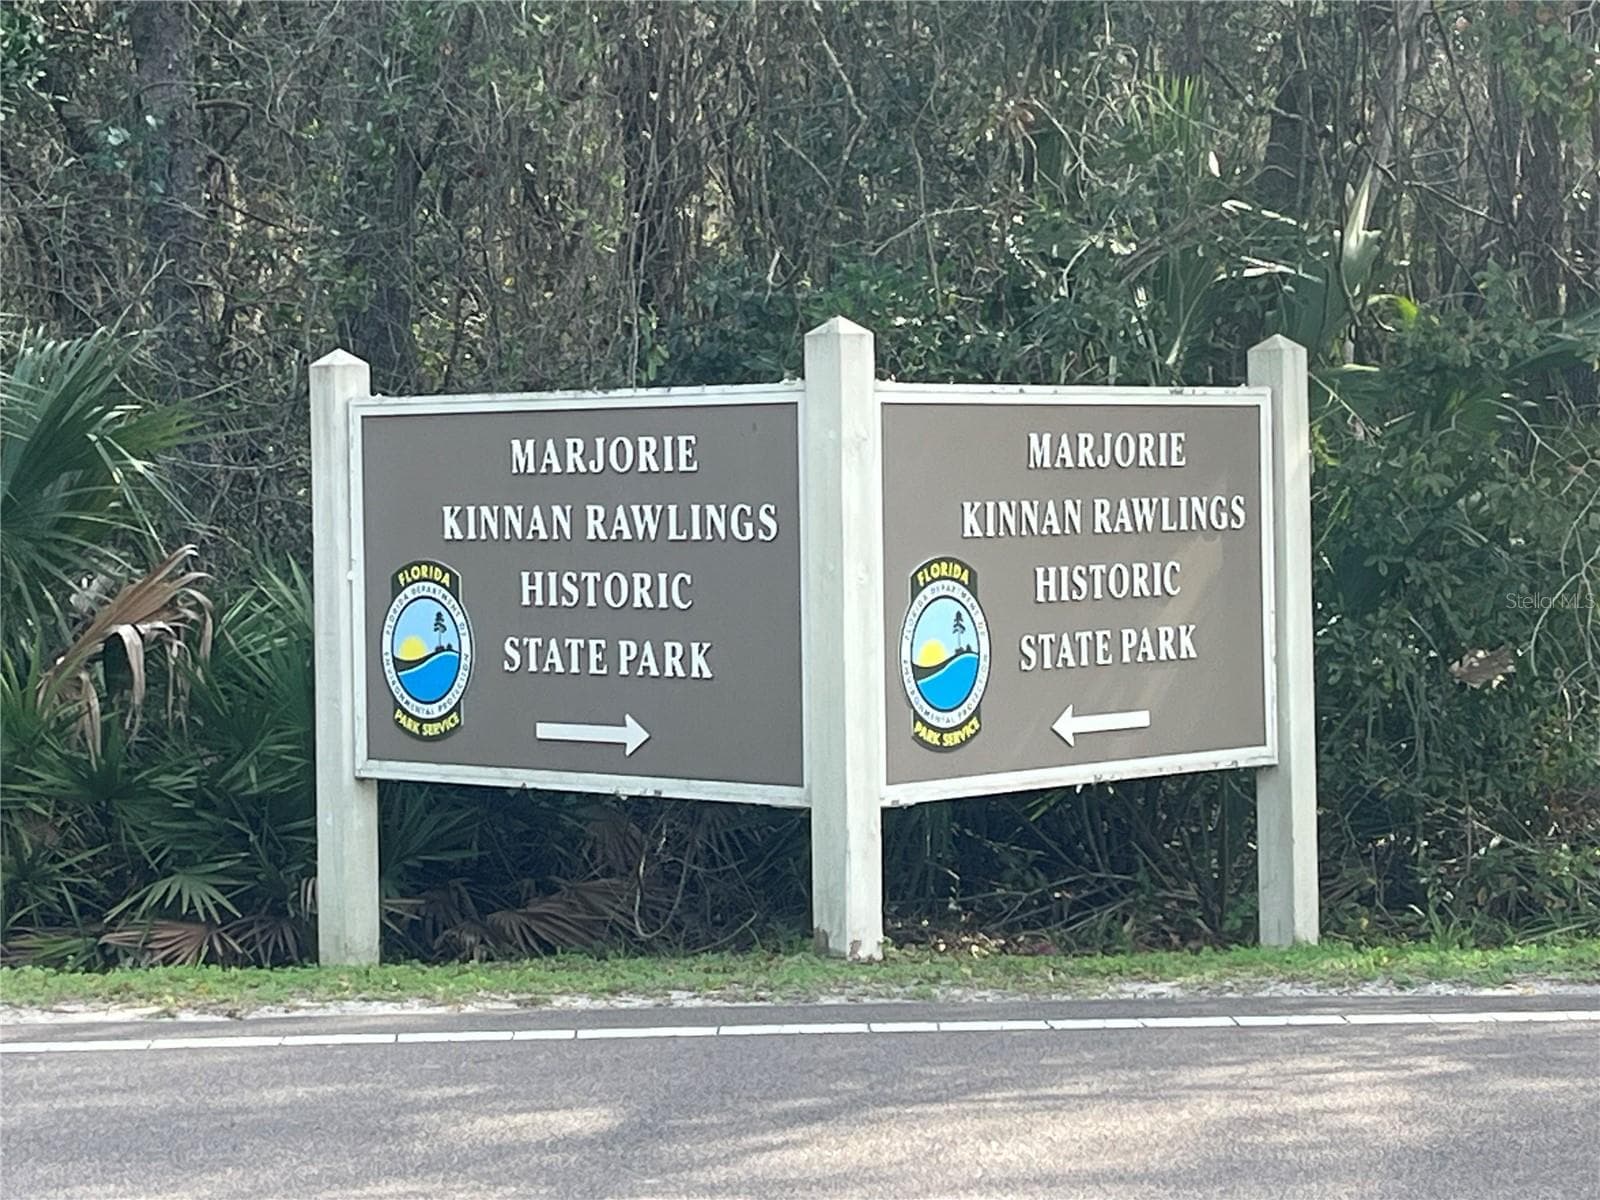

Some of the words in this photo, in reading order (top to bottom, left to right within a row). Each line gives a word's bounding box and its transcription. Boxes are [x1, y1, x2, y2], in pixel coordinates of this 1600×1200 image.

[511, 435, 699, 475] MARJORIE
[1028, 432, 1187, 470] MARJORIE
[442, 504, 573, 542] KINNAN
[585, 503, 778, 542] RAWLINGS
[962, 498, 1083, 539] KINNAN
[1093, 495, 1247, 534] RAWLINGS
[398, 564, 451, 588] FLORIDA
[520, 571, 693, 609] HISTORIC
[917, 561, 969, 587] FLORIDA
[1035, 560, 1182, 603] HISTORIC
[503, 636, 609, 675] STATE
[618, 640, 714, 679] PARK
[1020, 629, 1114, 672] STATE
[1120, 624, 1199, 664] PARK
[394, 708, 421, 735] PARK
[421, 711, 460, 737] SERVICE
[914, 720, 941, 746] PARK
[942, 716, 980, 747] SERVICE
